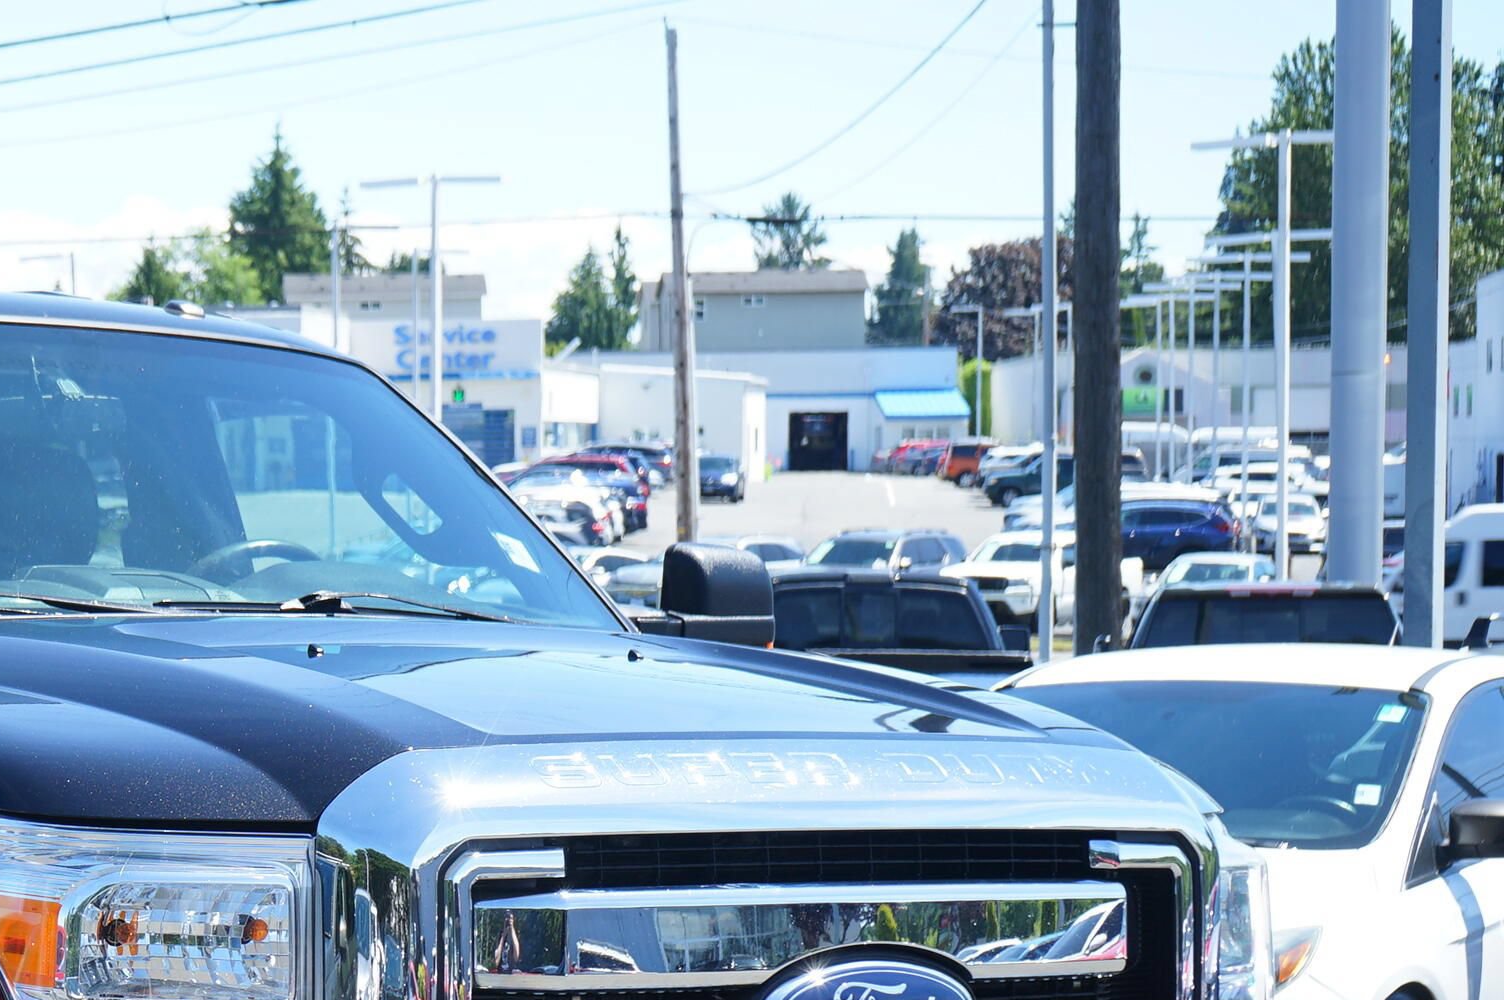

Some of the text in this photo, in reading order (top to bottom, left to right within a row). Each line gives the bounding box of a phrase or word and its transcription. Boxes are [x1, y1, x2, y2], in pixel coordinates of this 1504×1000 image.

[394, 325, 496, 345] Svice
[528, 751, 1109, 789] SUPER DUTY
